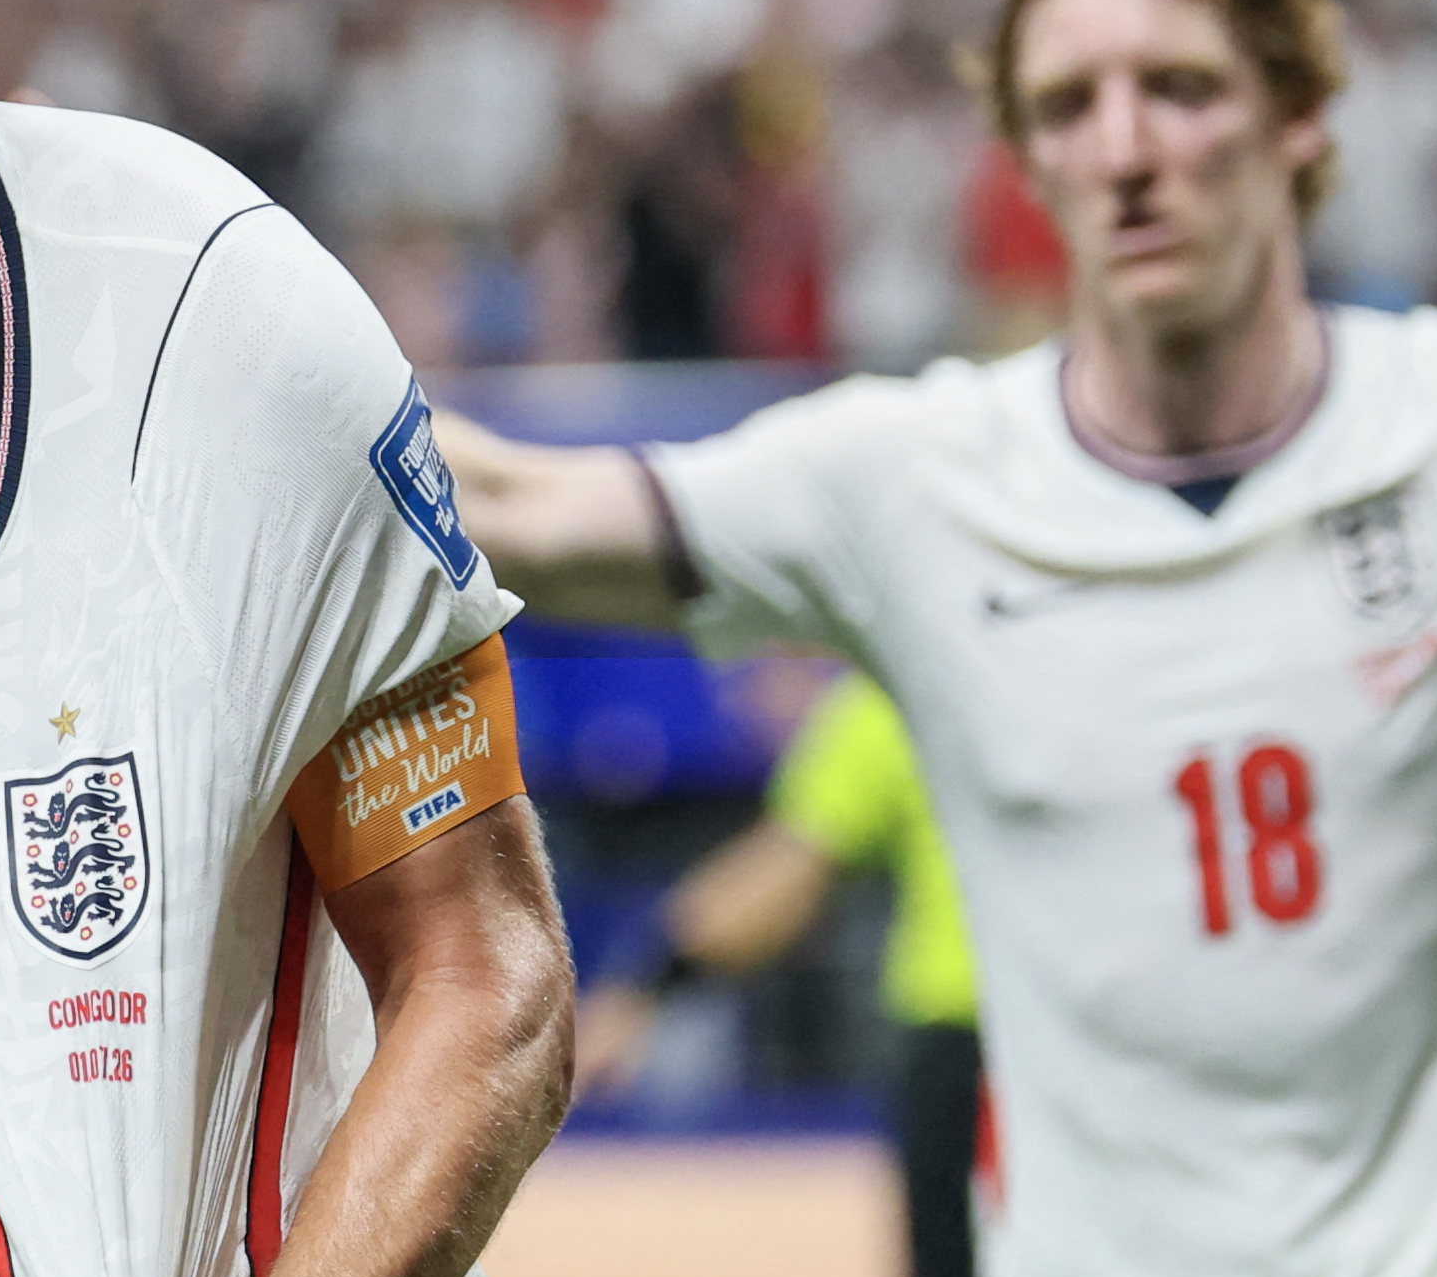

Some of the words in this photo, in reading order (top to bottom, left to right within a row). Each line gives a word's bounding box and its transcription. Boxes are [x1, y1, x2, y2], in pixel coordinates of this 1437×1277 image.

[331, 676, 477, 783] UNITES
[338, 781, 400, 828] the
[400, 717, 490, 794] World
[408, 789, 462, 828] FIFA
[1174, 739, 1326, 940] 18
[48, 989, 116, 1030] CONGO
[119, 991, 147, 1025] DR
[68, 1045, 133, 1083] 01.07.26
